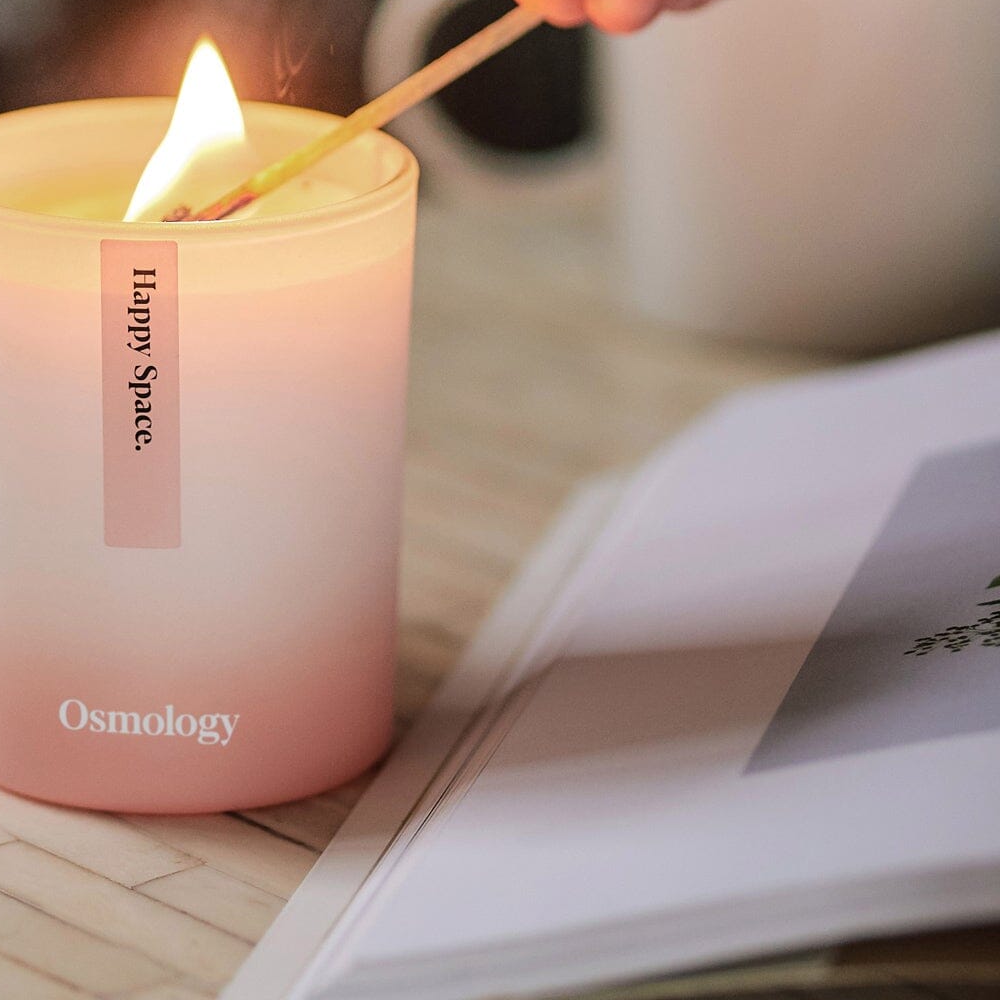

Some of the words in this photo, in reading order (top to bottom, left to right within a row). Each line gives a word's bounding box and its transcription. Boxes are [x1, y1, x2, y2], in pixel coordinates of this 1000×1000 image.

[127, 268, 156, 357] Happy
[128, 365, 158, 451] Space.
[58, 698, 240, 747] Osmology
